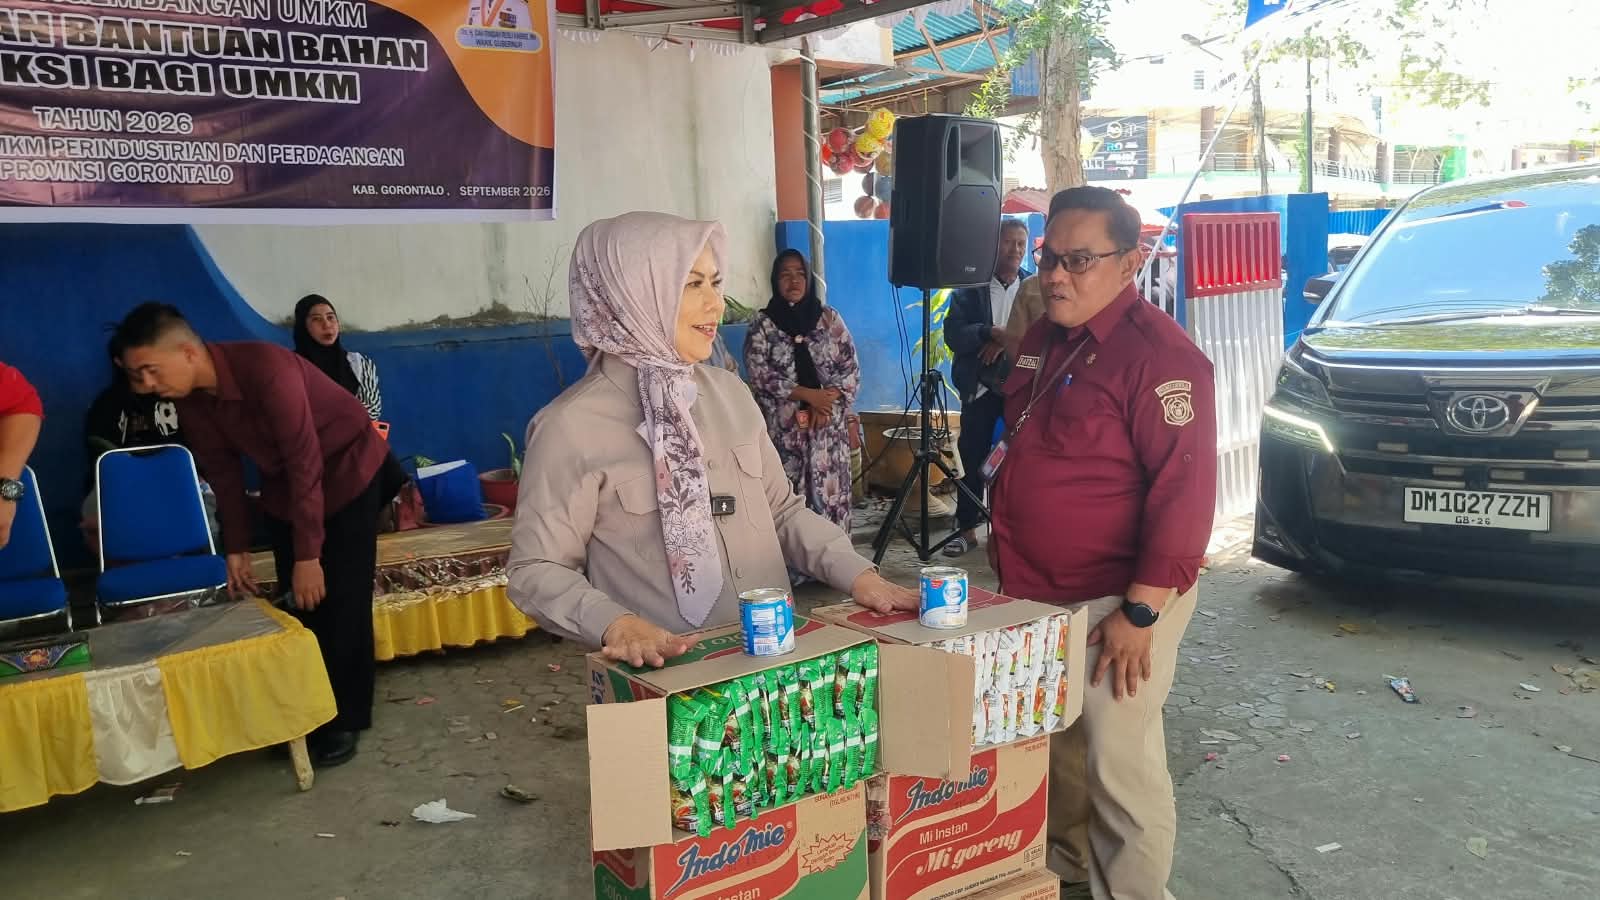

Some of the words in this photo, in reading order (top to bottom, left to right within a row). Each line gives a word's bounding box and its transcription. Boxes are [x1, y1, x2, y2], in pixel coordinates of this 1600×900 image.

[277, 0, 367, 28] UMKM
[61, 13, 284, 62] BANTUAN
[288, 31, 428, 72] BAHAN
[0, 51, 90, 89] KSI
[95, 57, 215, 96] BAGI
[220, 64, 361, 104] UMKM
[32, 107, 122, 132] TAHUN
[126, 111, 193, 135] 2026
[48, 136, 220, 162] PERINDUSTRIAN
[223, 143, 265, 163] DAN
[268, 144, 405, 167] PERDAGANGAN
[0, 160, 105, 182] PROVINSI
[108, 162, 234, 184] GORONTALO
[352, 184, 378, 195] KAB.
[459, 186, 520, 197] SEPTEMBER
[523, 186, 550, 197] 2026
[919, 832, 933, 846] Mi
[935, 821, 968, 841] Instan
[915, 847, 951, 877] Mi
[951, 829, 1023, 871] goreng
